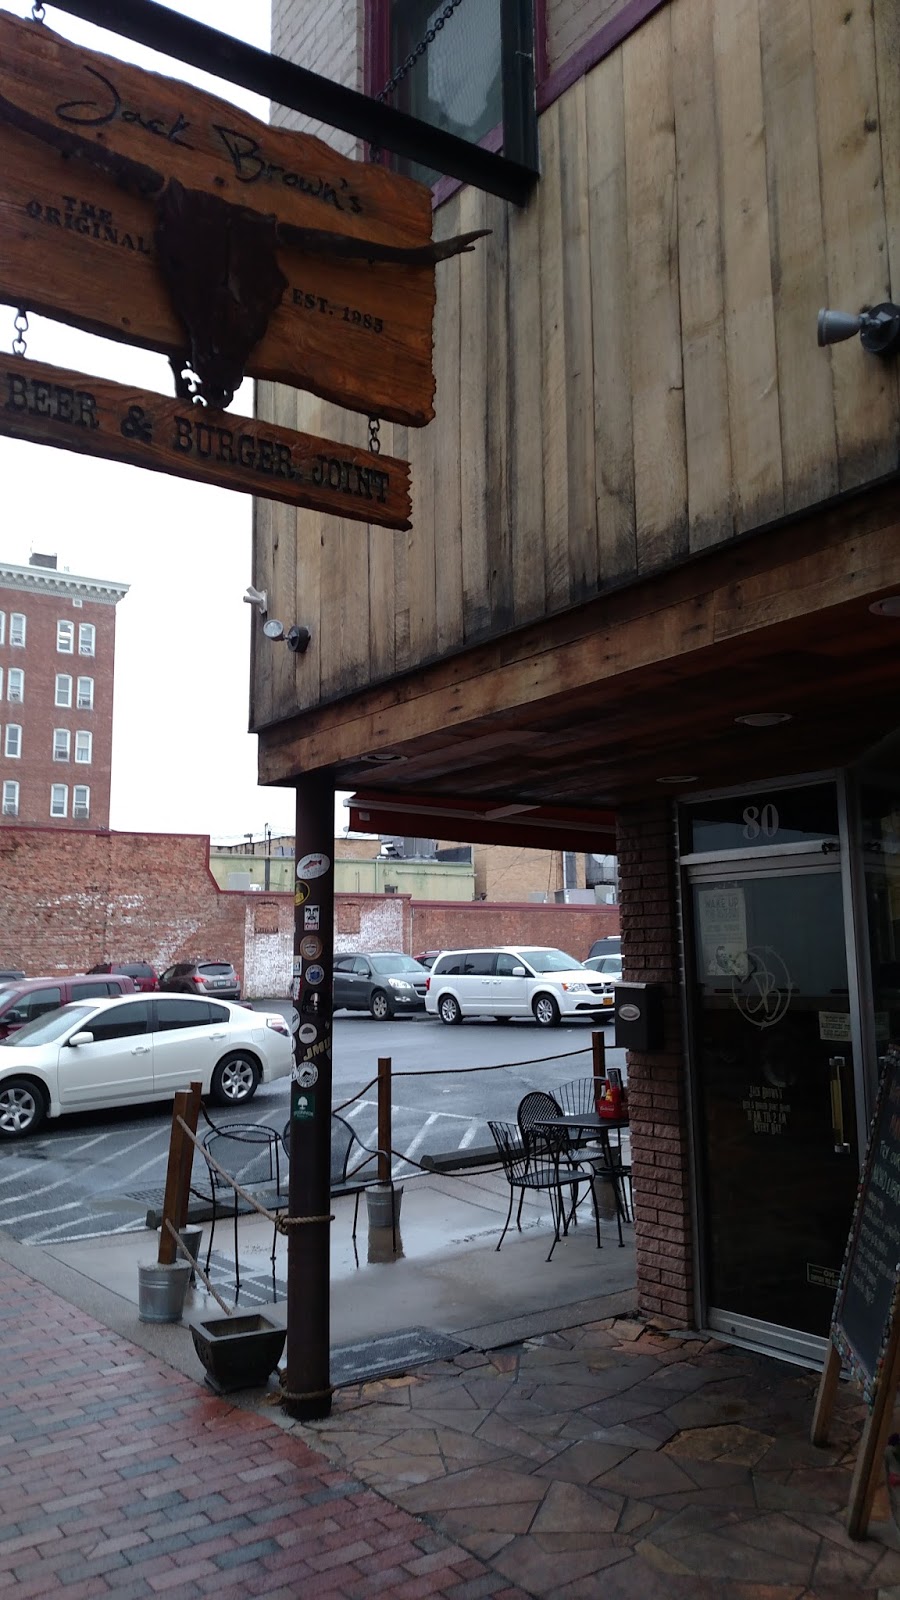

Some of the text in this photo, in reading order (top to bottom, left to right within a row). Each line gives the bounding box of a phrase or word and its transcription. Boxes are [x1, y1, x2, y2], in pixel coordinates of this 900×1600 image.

[56, 65, 364, 213] Jack Brown's
[26, 200, 150, 255] ORIGINAL
[62, 195, 112, 224] THE
[293, 288, 383, 333] EST. 1985
[5, 372, 389, 503] BEER & BURGER JOINT
[743, 803, 779, 839] 80
